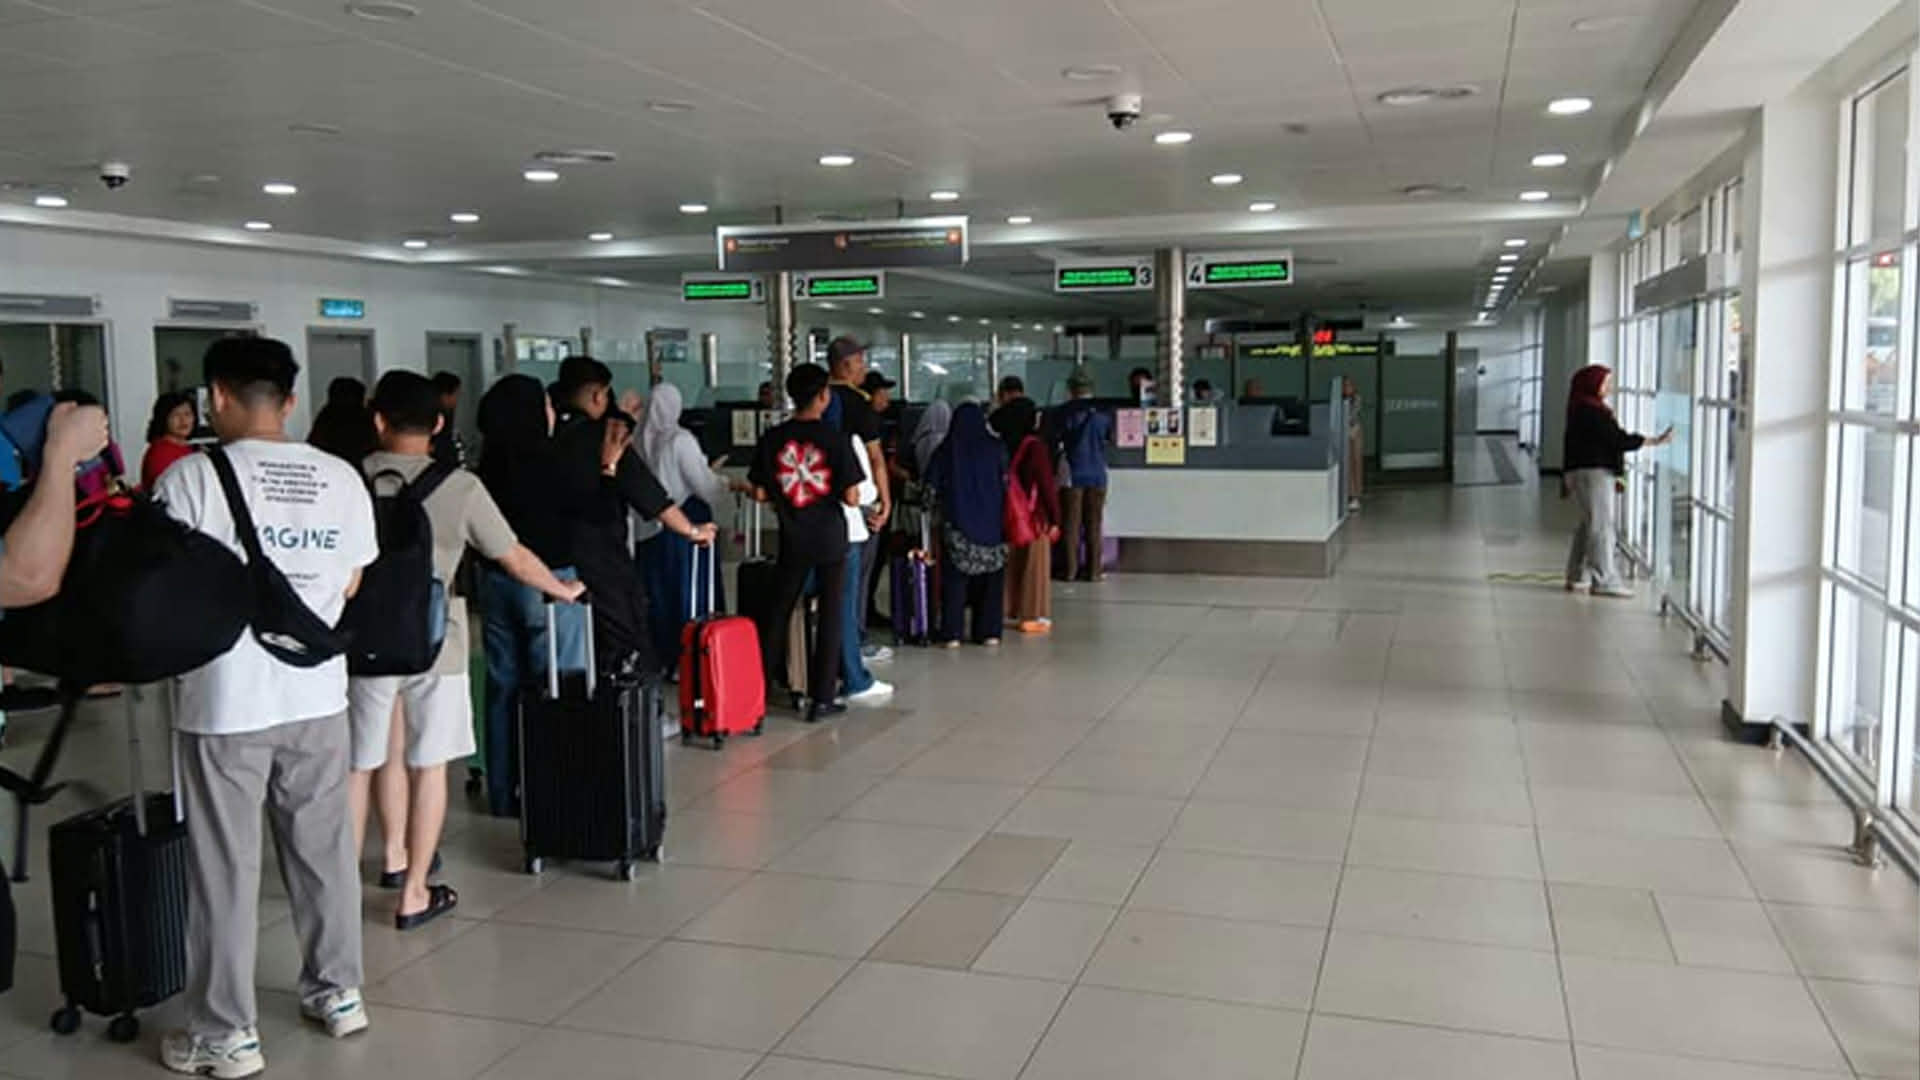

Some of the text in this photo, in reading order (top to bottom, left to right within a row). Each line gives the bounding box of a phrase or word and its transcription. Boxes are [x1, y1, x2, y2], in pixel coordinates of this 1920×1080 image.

[1139, 265, 1152, 285] 3
[1189, 264, 1202, 283] 4
[795, 278, 806, 297] 2
[256, 525, 341, 550] AGINE
